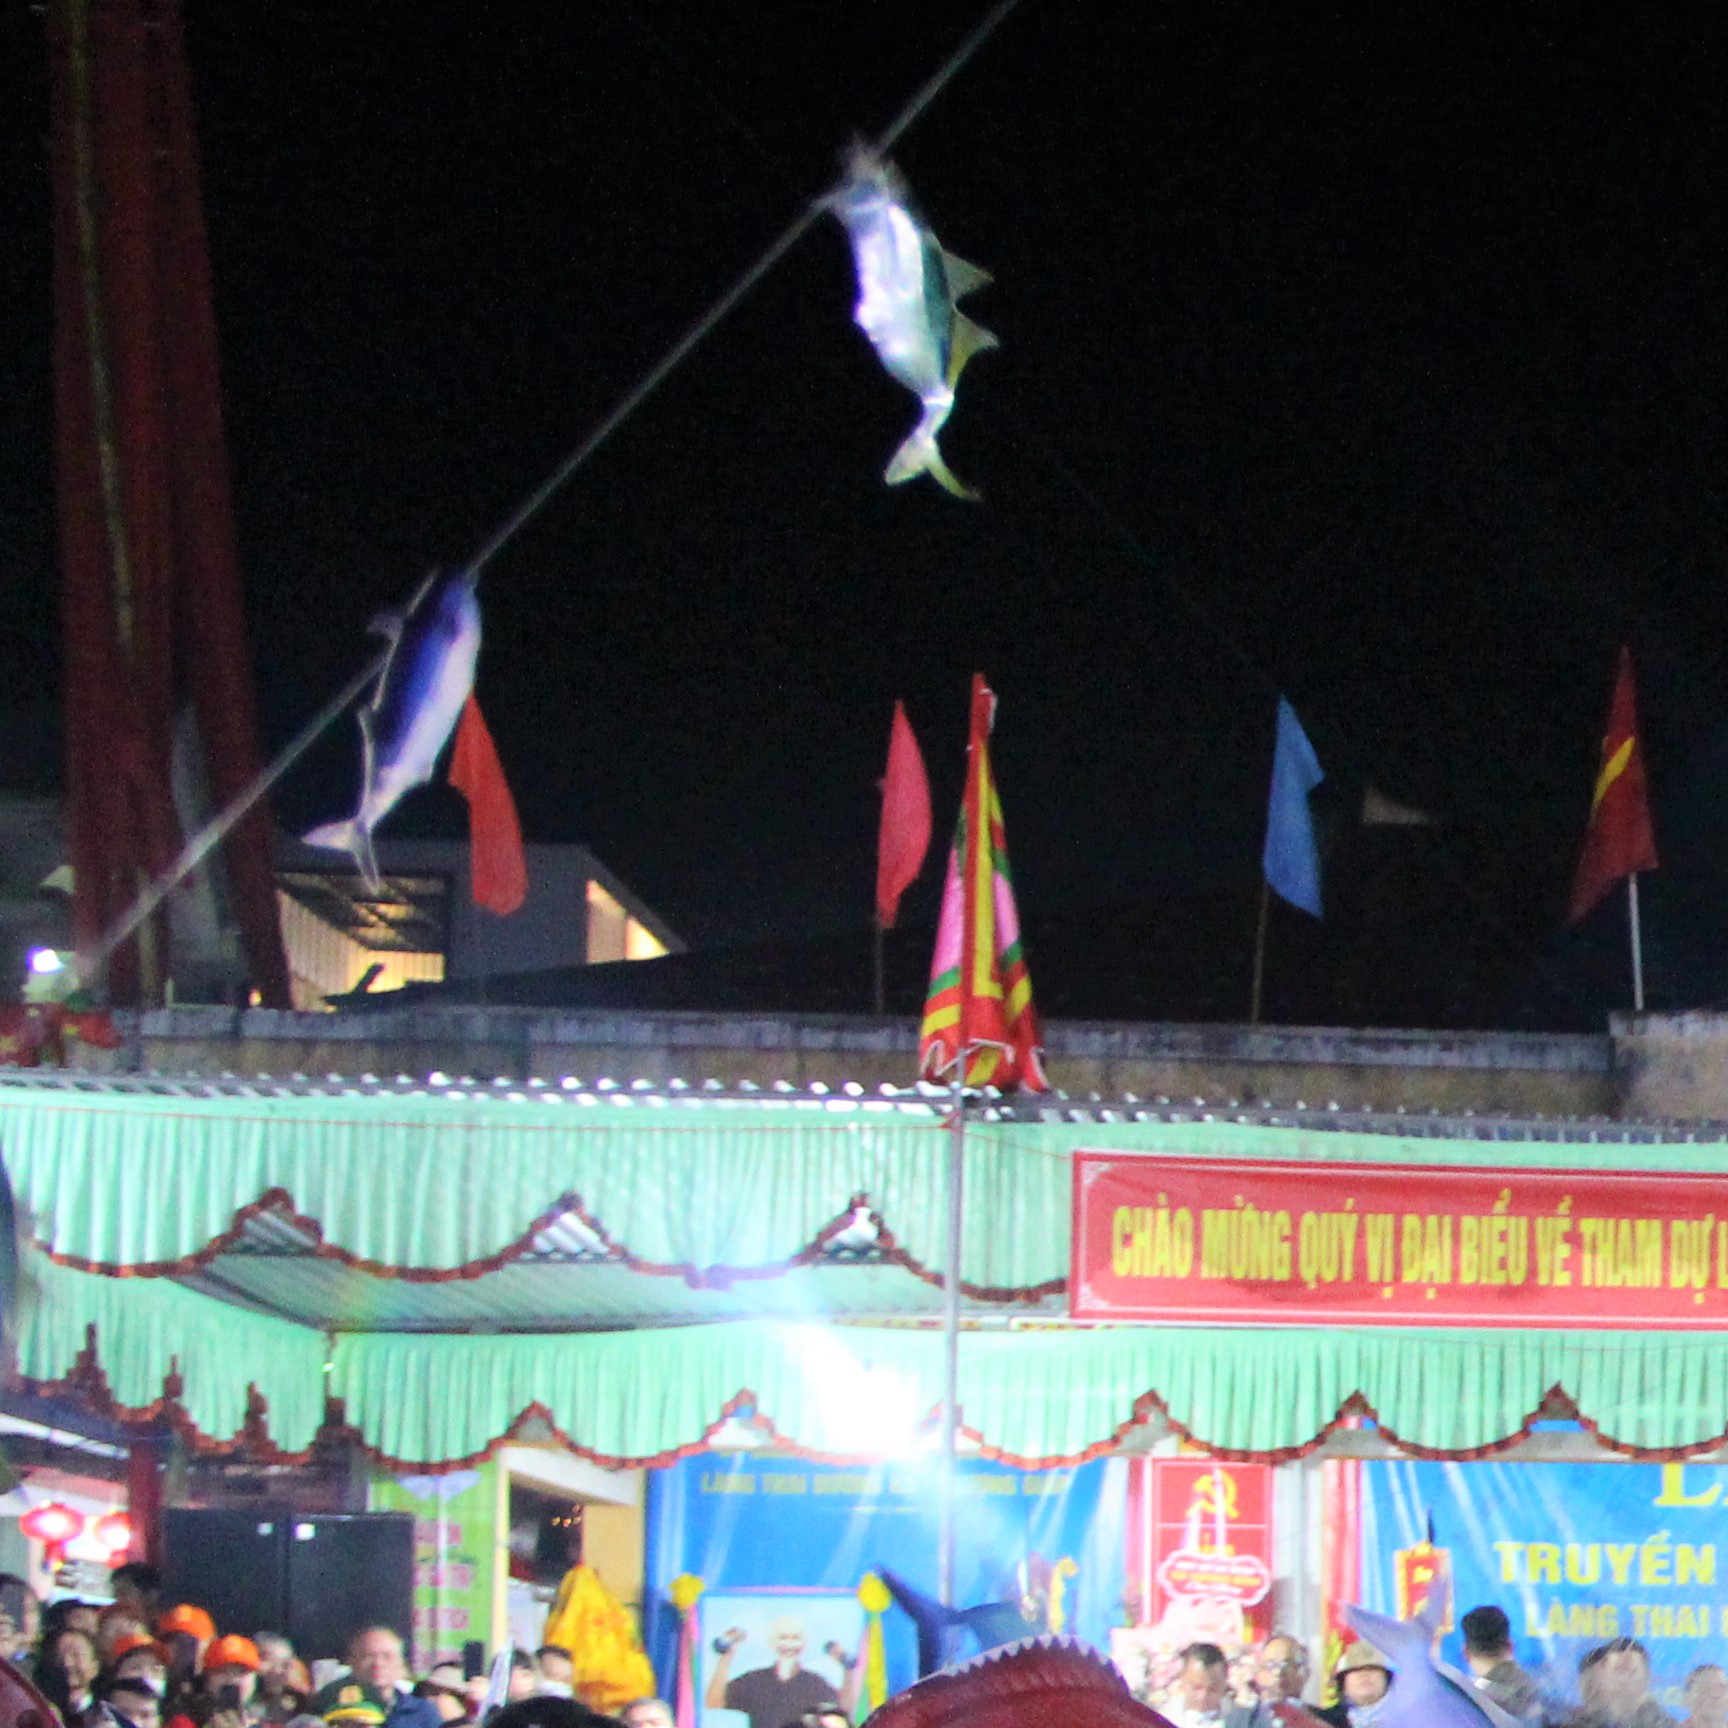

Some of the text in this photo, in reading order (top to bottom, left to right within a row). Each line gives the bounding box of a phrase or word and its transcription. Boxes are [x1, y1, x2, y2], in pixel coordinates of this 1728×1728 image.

[1112, 1191, 1194, 1278] CHÀO
[1200, 1194, 1292, 1281] MỪNG
[1300, 1197, 1360, 1290] QUÝ
[1364, 1213, 1395, 1299] VỊ
[1401, 1214, 1453, 1300] ĐẠI
[1459, 1187, 1529, 1286] BIỂU
[1534, 1194, 1573, 1287] VỀ
[1578, 1217, 1663, 1288] THAM
[1669, 1212, 1715, 1304] DỰ
[1630, 1603, 1710, 1638] THAI
